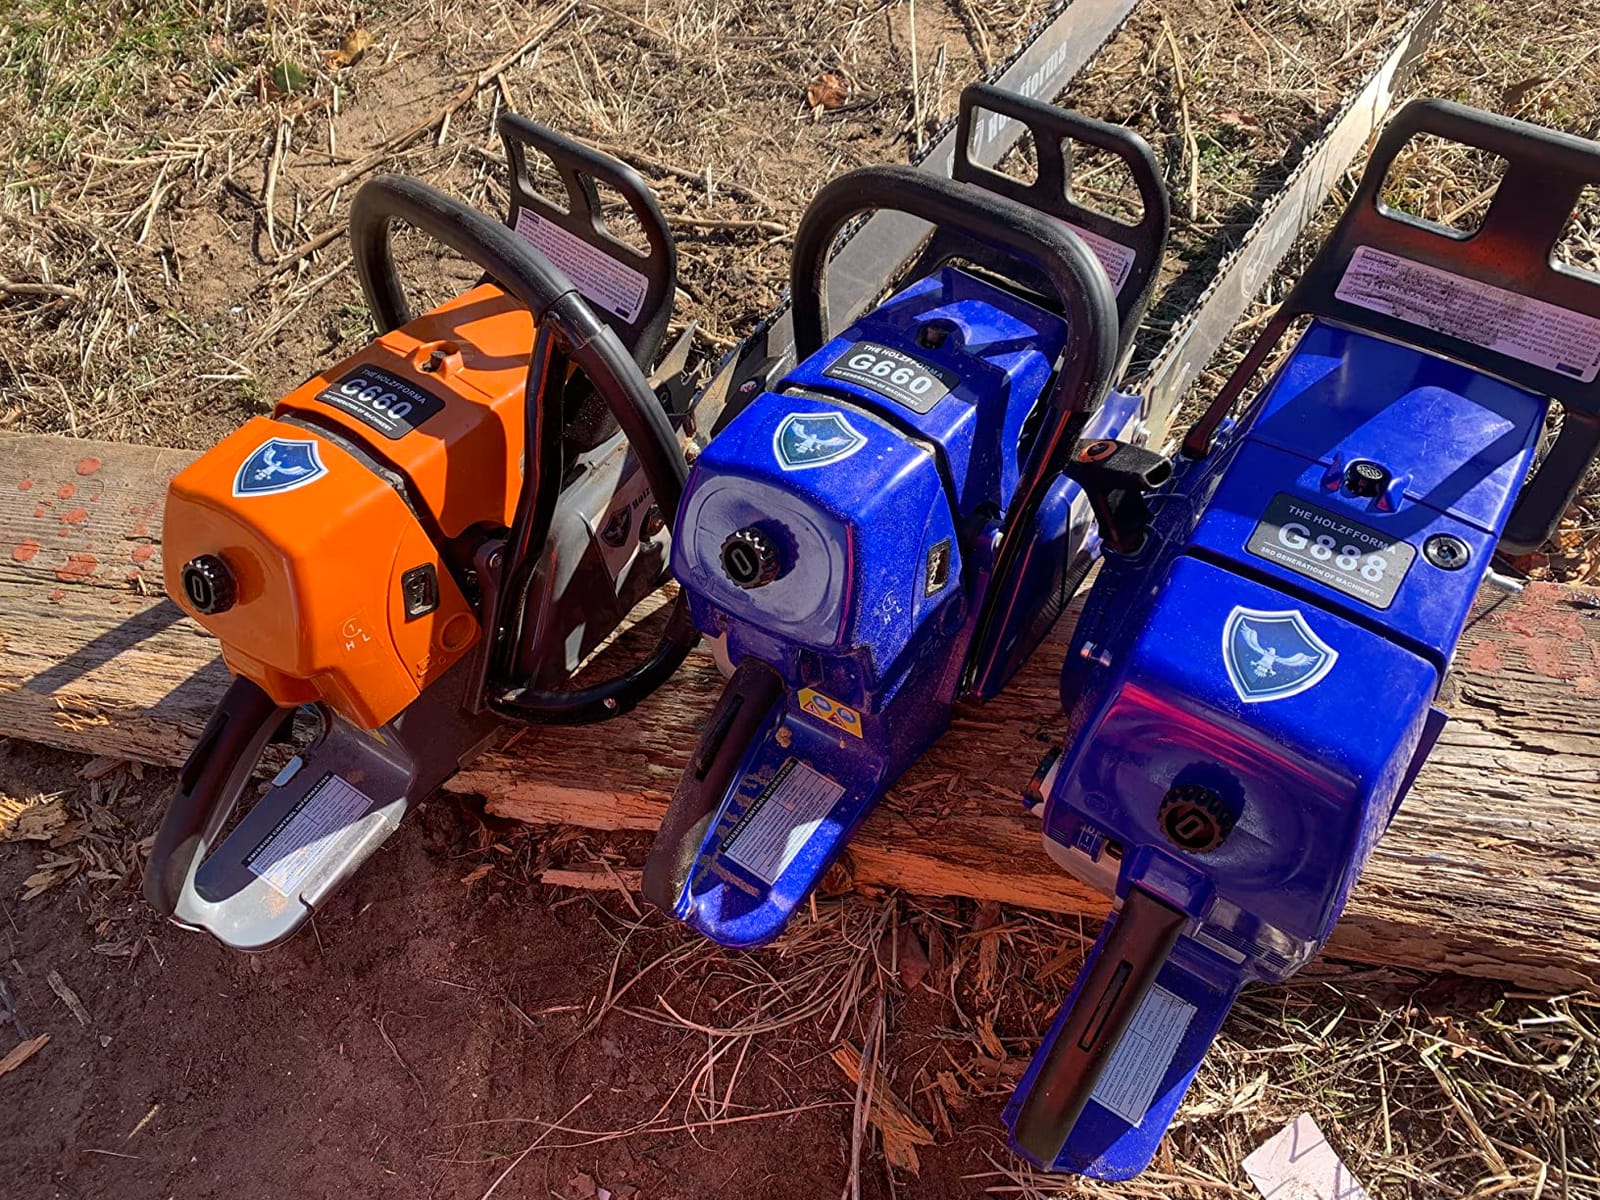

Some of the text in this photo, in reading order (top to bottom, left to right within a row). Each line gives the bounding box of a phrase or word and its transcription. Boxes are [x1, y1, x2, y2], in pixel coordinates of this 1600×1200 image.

[864, 345, 880, 353] THE
[848, 354, 933, 394] G660
[341, 379, 413, 419] G660
[1278, 522, 1388, 582] G888
[1289, 505, 1396, 555] THE HOLZFFORMA
[1276, 551, 1325, 576] GENERATION
[1325, 570, 1335, 581] OF
[1336, 575, 1381, 600] MACHINERY
[345, 640, 355, 652] H
[247, 834, 273, 862] EMISSION
[271, 809, 296, 835] CONTROL
[722, 820, 746, 847] EMISSION
[743, 796, 766, 822] CONTROL
